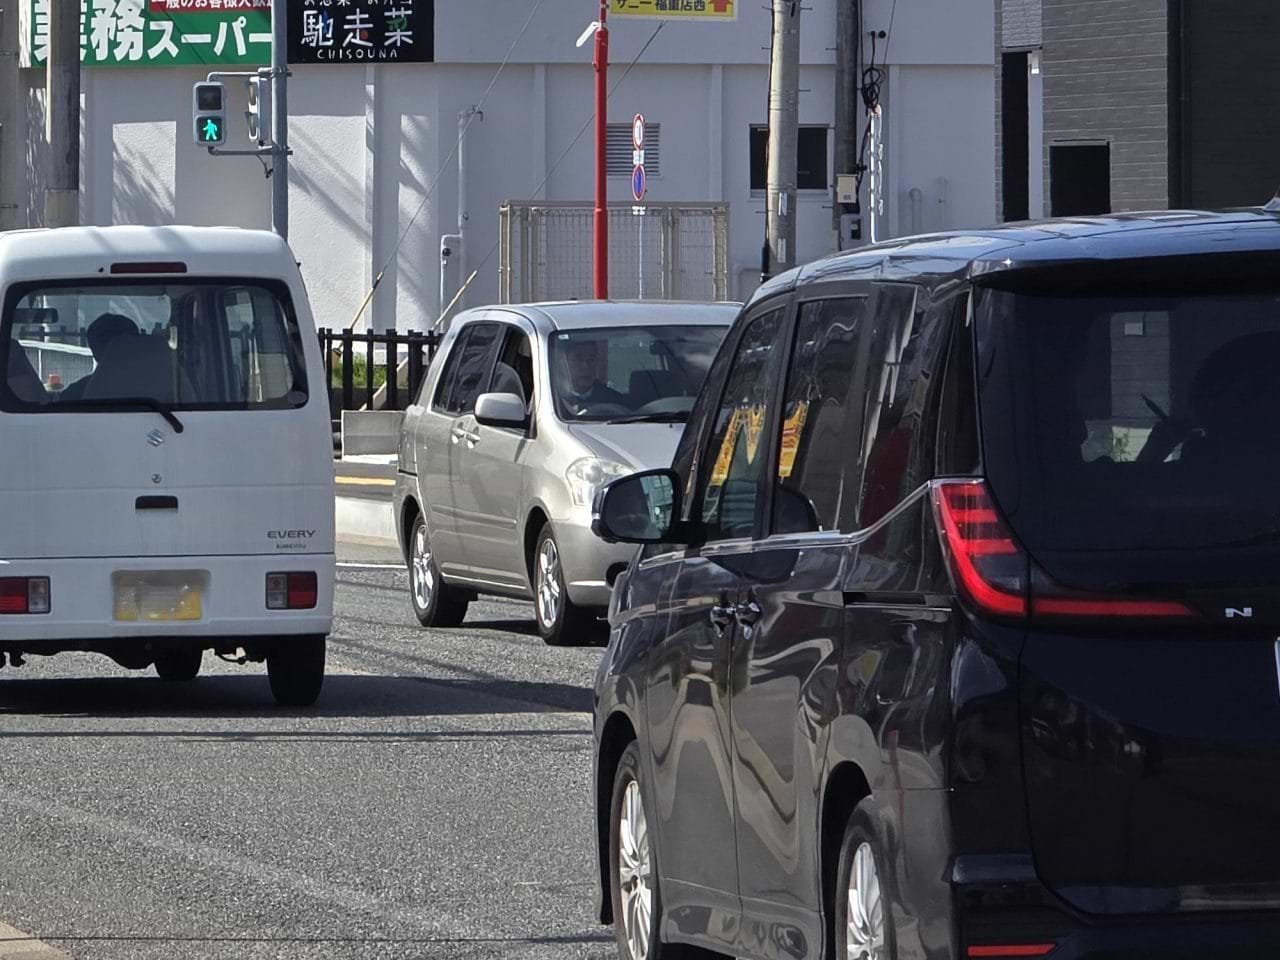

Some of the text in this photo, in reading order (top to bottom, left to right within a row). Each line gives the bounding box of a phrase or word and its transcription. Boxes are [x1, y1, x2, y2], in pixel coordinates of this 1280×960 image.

[301, 7, 414, 47] 馳走菜
[317, 49, 398, 60] CHISOUNA
[267, 529, 316, 539] EVERY
